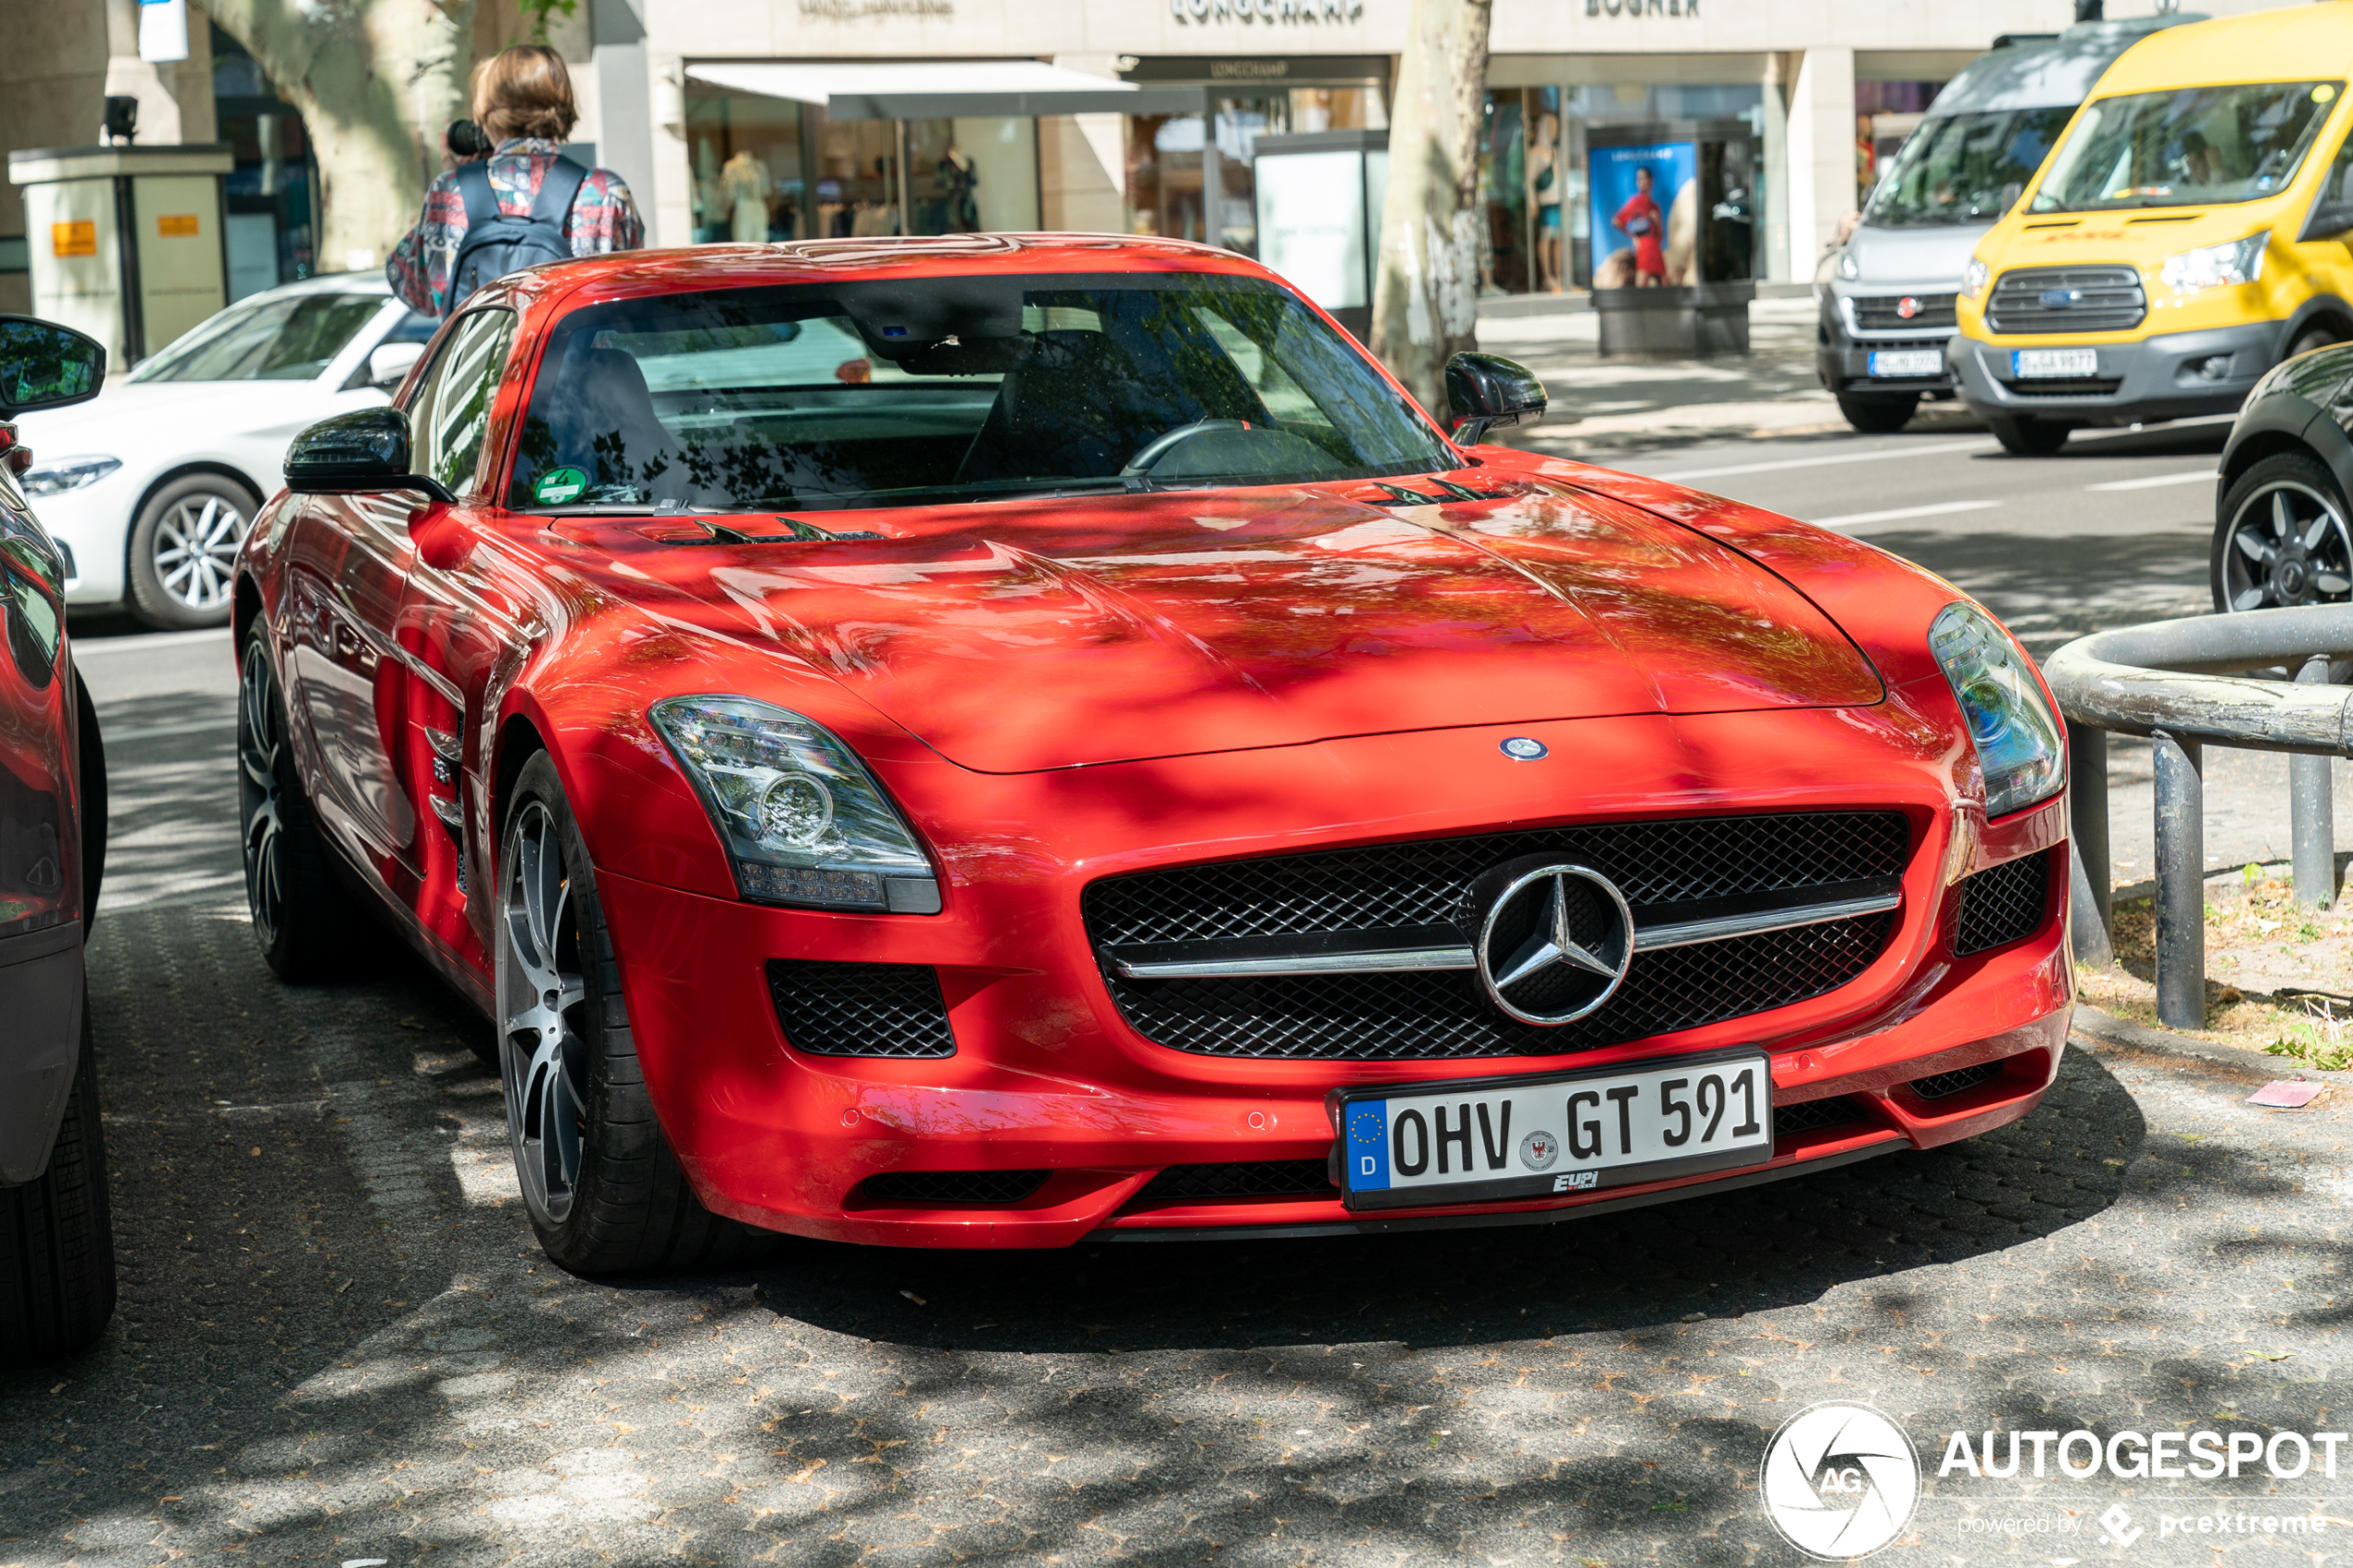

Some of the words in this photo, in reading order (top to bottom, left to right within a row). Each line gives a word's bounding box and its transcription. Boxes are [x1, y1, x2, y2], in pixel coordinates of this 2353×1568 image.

[1170, 0, 1364, 22] LONGCHAMP
[555, 470, 569, 486] 4
[1361, 1156, 1377, 1175] D
[1393, 1099, 1512, 1177] OHV
[1567, 1085, 1639, 1160] GT
[1661, 1068, 1760, 1147] 591
